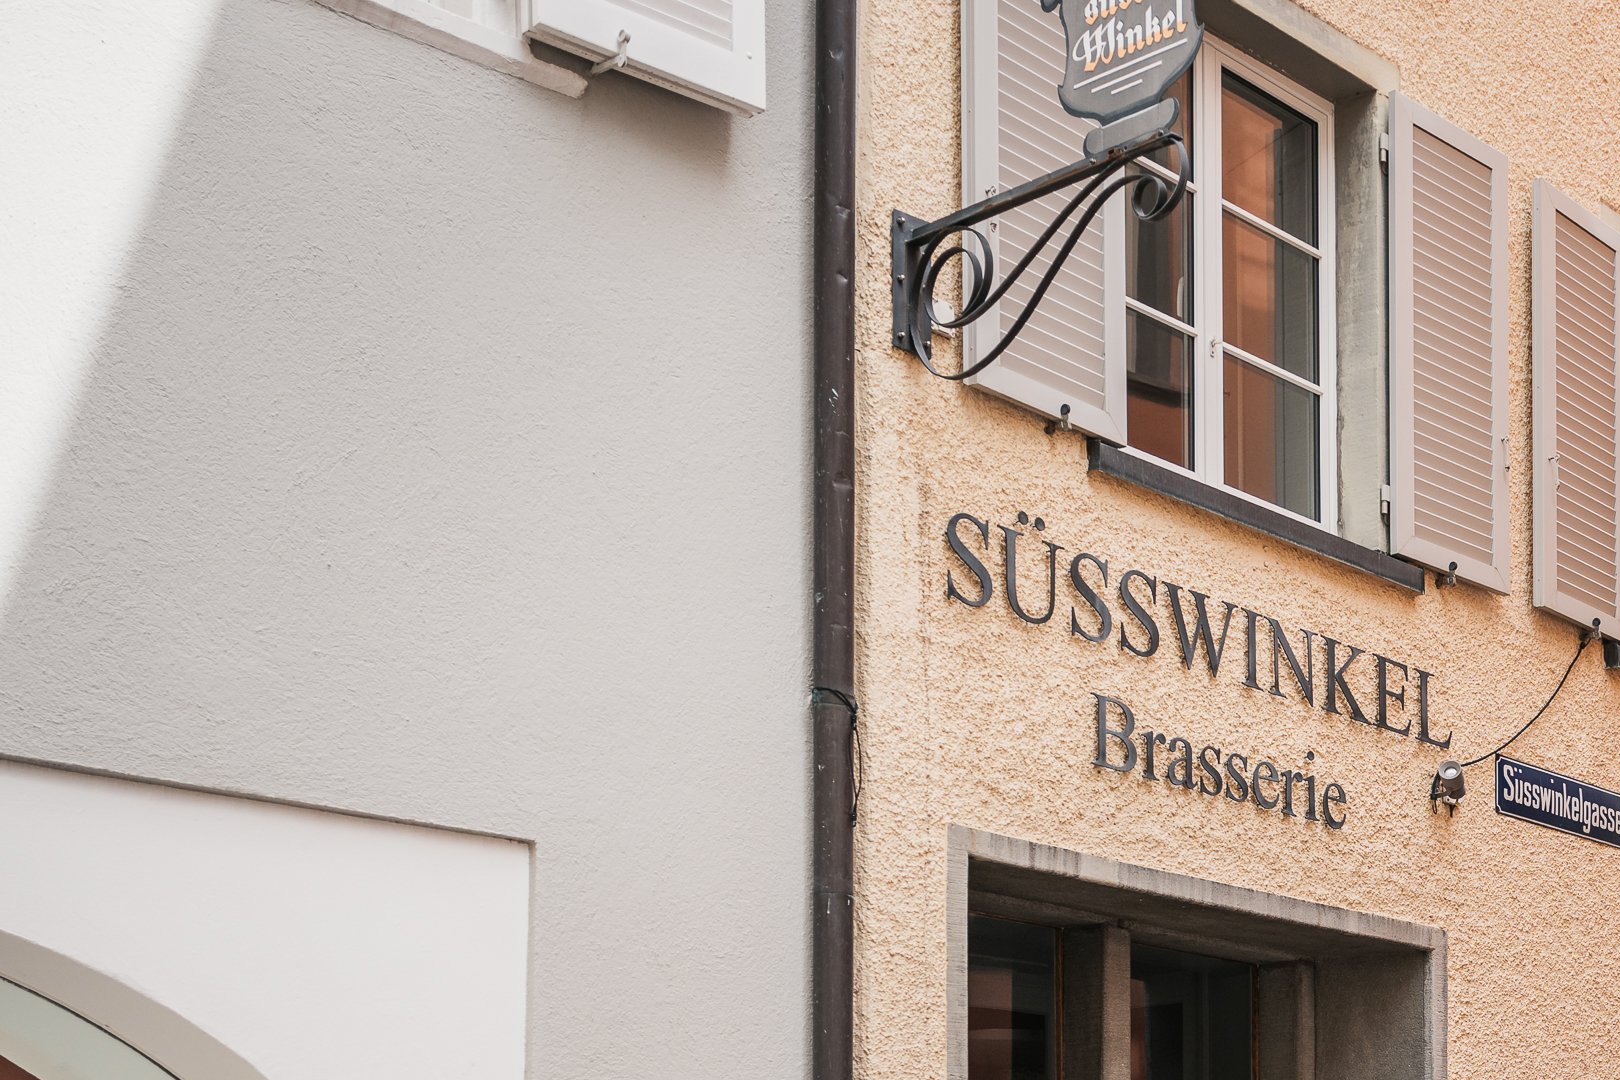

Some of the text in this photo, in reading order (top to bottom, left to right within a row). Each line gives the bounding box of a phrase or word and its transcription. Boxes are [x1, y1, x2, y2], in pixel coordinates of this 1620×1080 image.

[1072, 0, 1188, 72] Winkel
[945, 511, 1453, 750] SÜSSWINKEL
[1090, 692, 1348, 830] Brasserie
